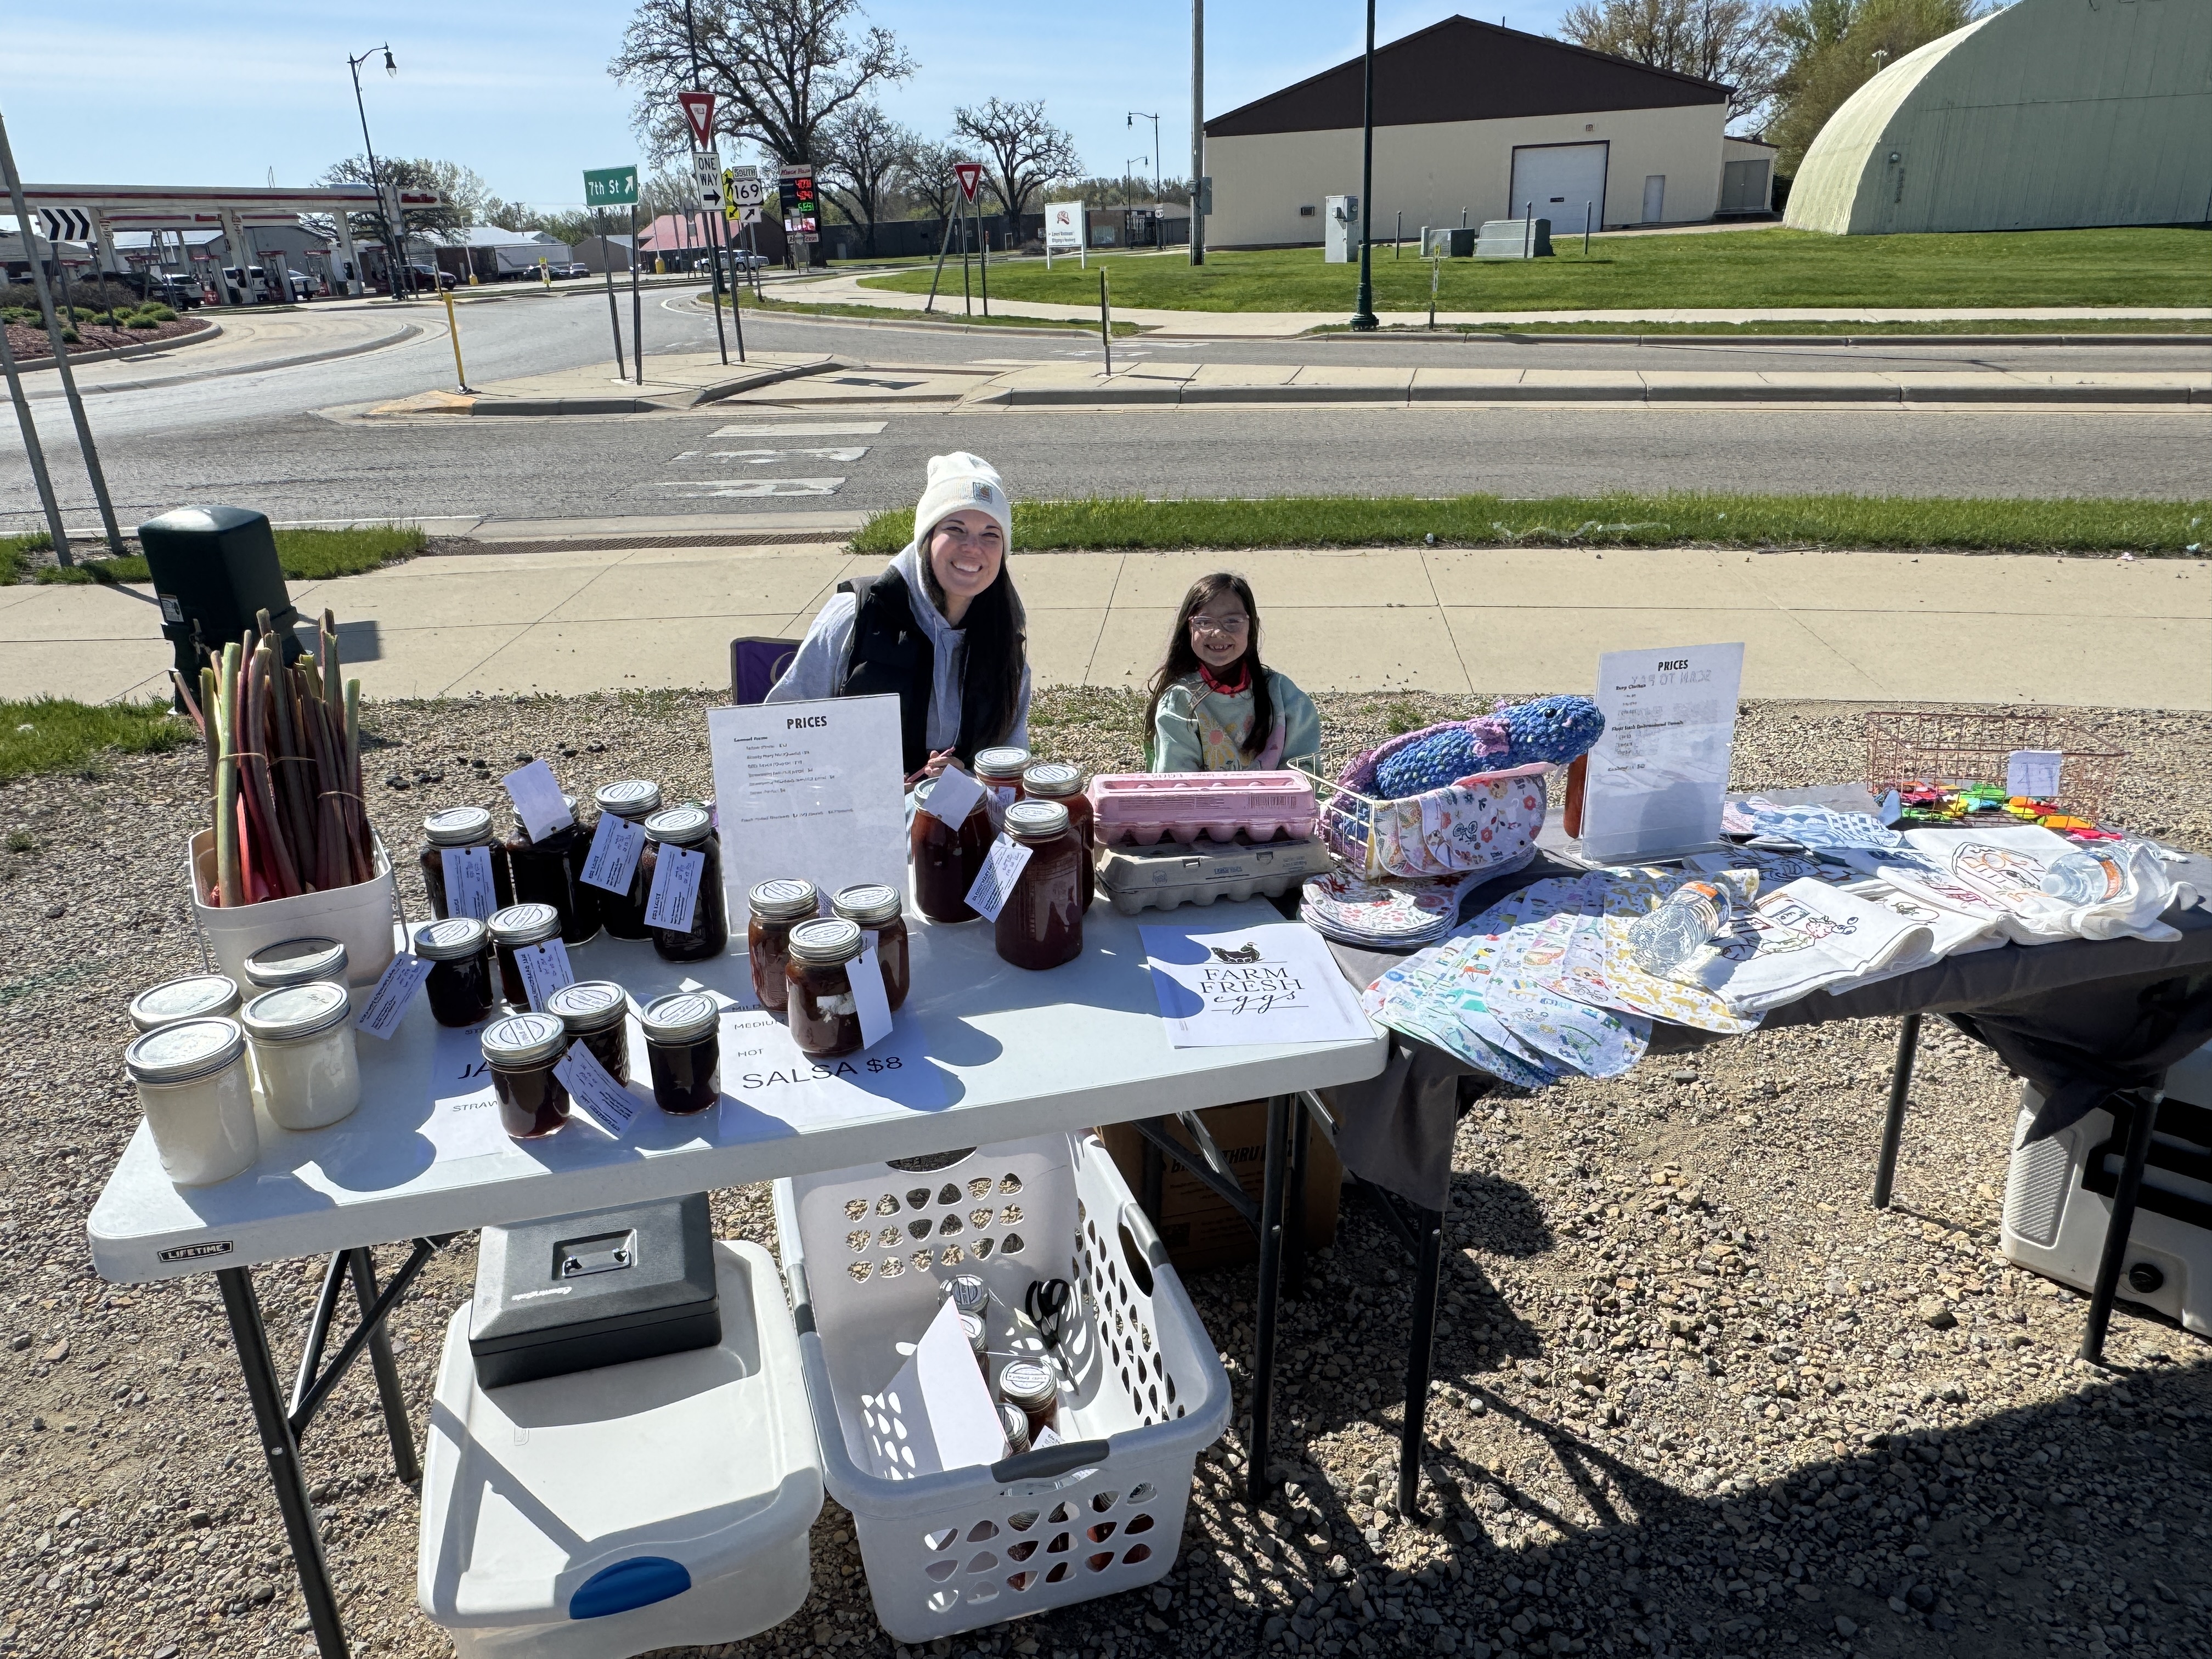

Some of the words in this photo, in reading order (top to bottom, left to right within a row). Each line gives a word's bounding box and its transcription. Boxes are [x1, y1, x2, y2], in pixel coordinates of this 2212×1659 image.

[698, 157, 716, 170] ONE
[699, 173, 718, 186] WAY
[588, 181, 604, 196] 7th
[609, 179, 619, 194] St
[735, 184, 759, 199] 169
[1658, 659, 1688, 671] PRICES
[787, 716, 827, 729] PRICES
[1204, 968, 1289, 980] FARM
[1199, 979, 1306, 993] FRESH
[1214, 991, 1295, 1015] eggs
[738, 1048, 764, 1057] HOT
[458, 1060, 490, 1080] JA
[742, 1062, 858, 1088] SALSA
[866, 1057, 902, 1073] $8
